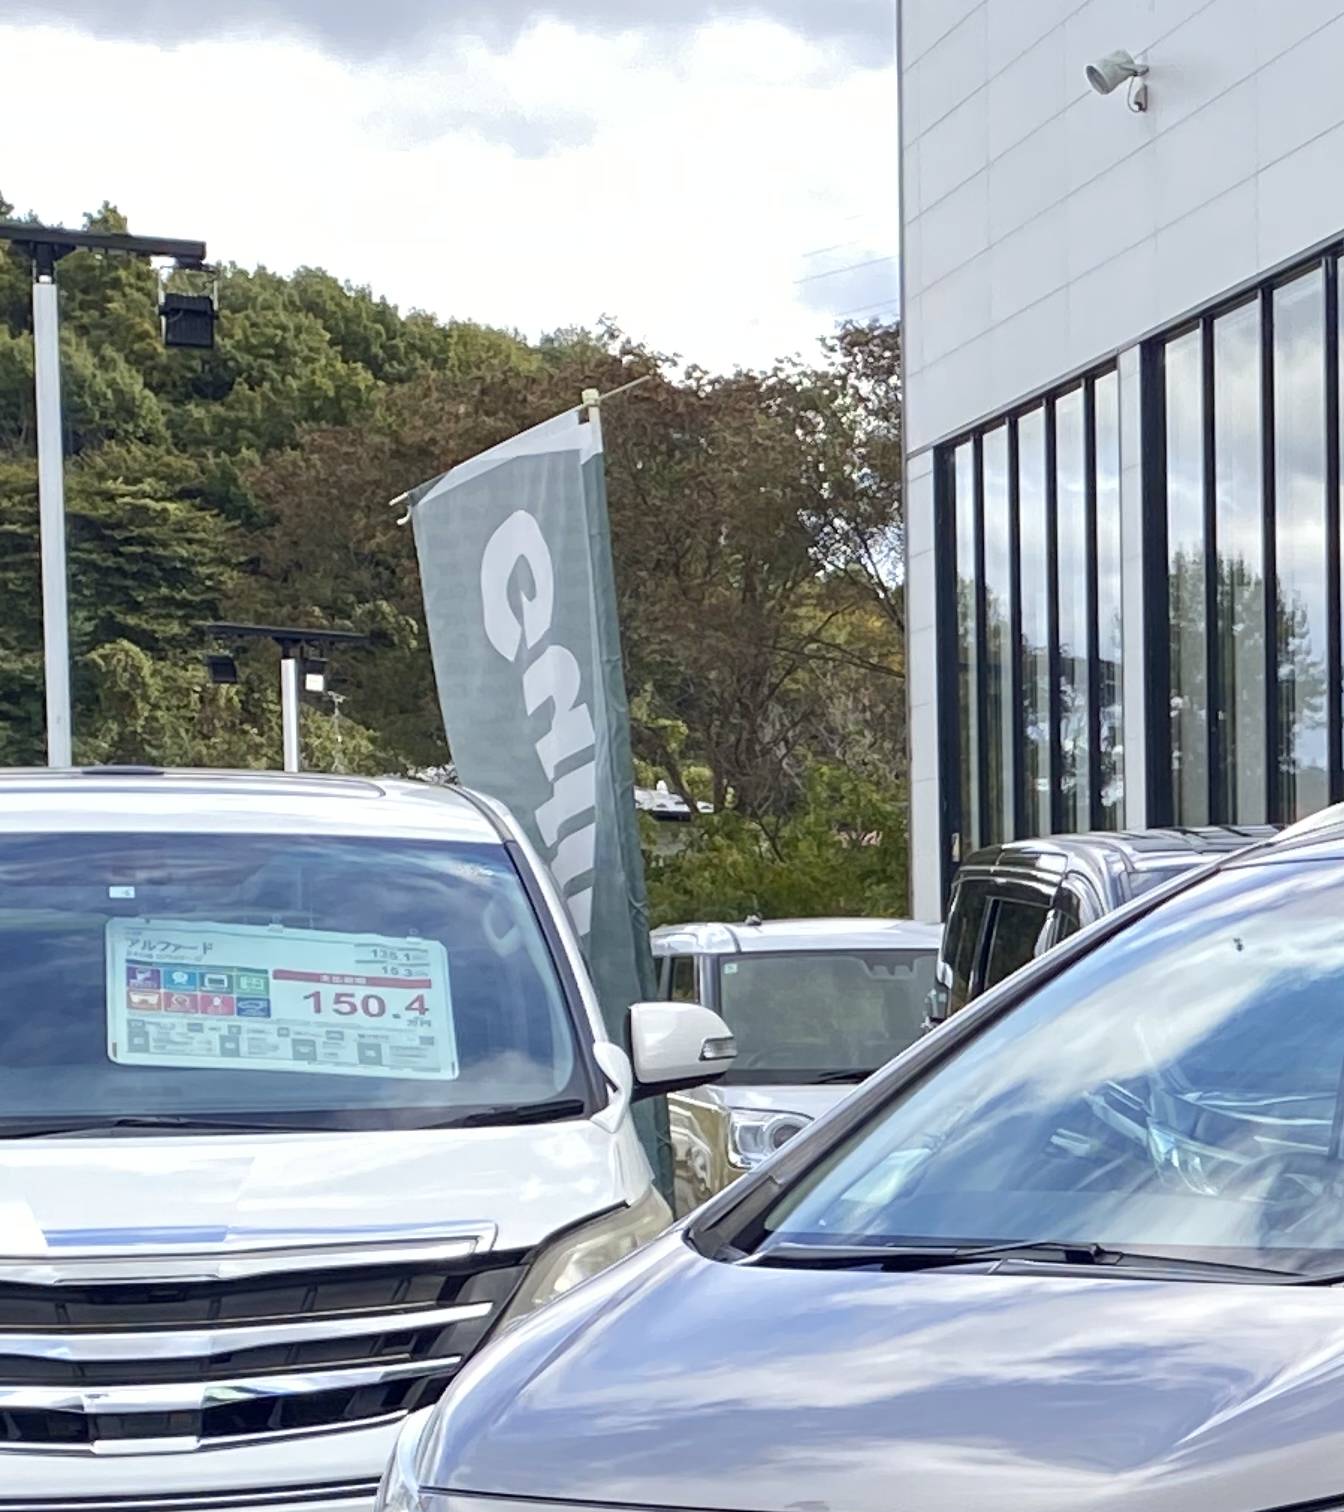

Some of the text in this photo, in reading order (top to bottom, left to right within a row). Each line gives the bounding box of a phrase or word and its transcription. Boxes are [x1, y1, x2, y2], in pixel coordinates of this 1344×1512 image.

[125, 937, 214, 955] アルファード
[303, 991, 430, 1019] 150.4
